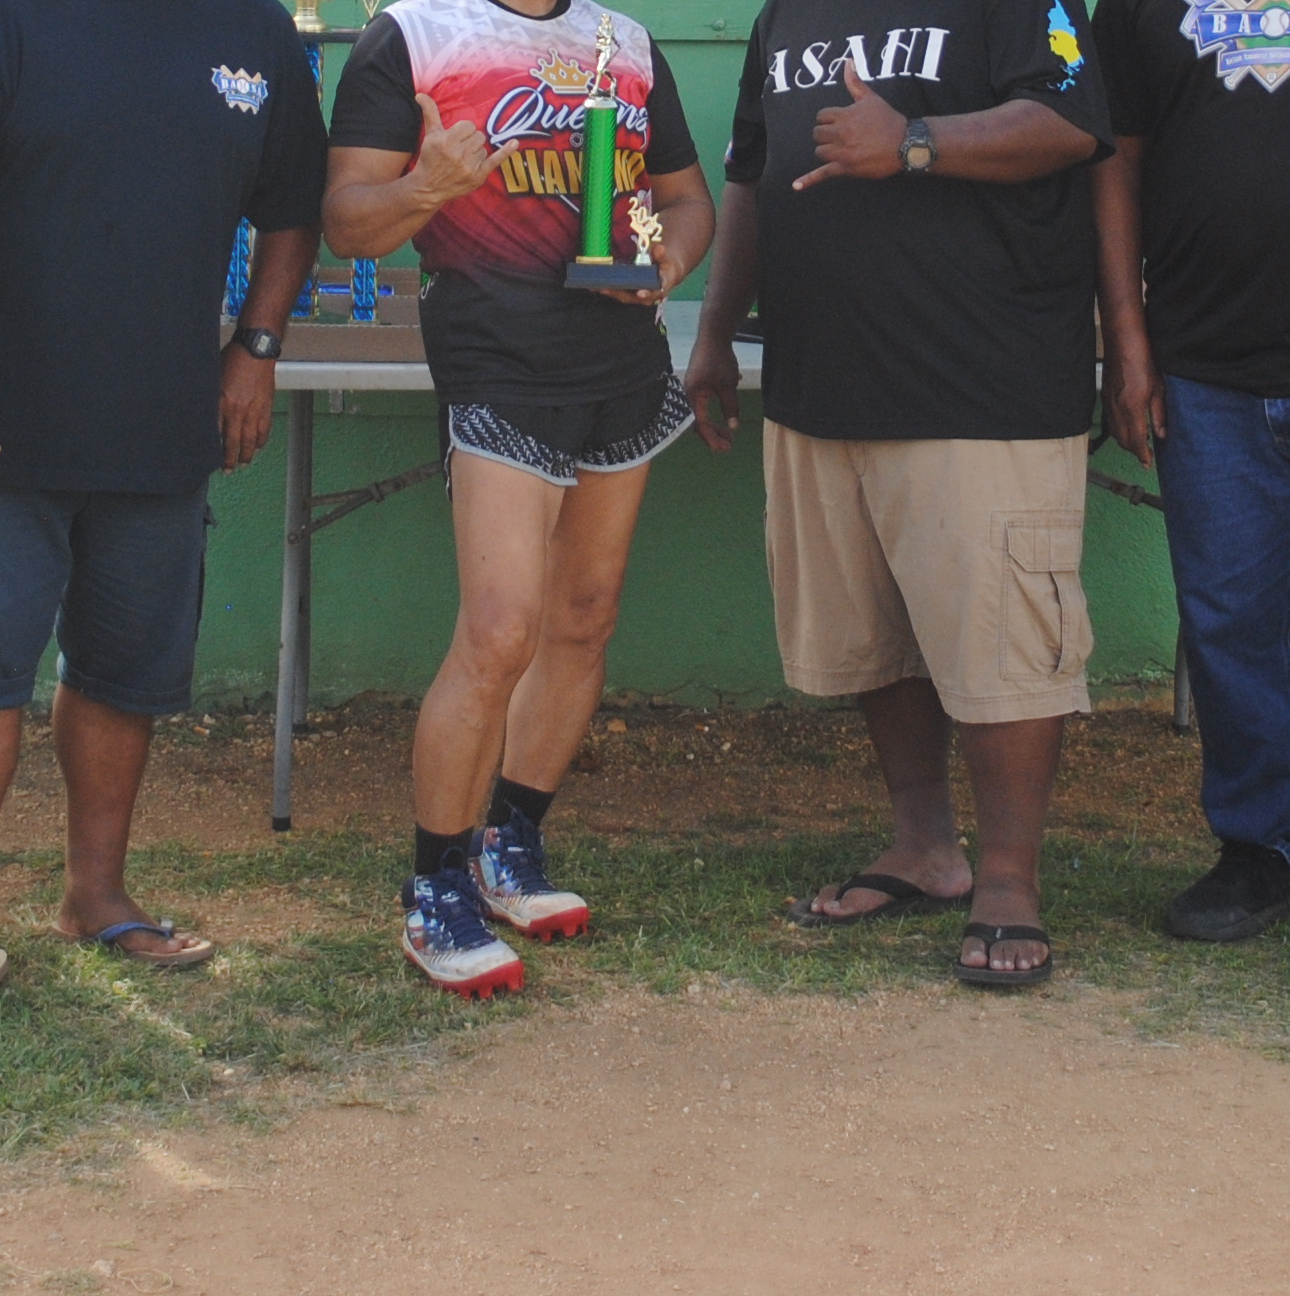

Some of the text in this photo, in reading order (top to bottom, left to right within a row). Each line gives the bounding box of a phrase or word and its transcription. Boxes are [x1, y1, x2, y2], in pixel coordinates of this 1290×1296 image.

[768, 26, 951, 94] ASAHI
[486, 85, 649, 145] Quens
[498, 148, 646, 195] DIAMND
